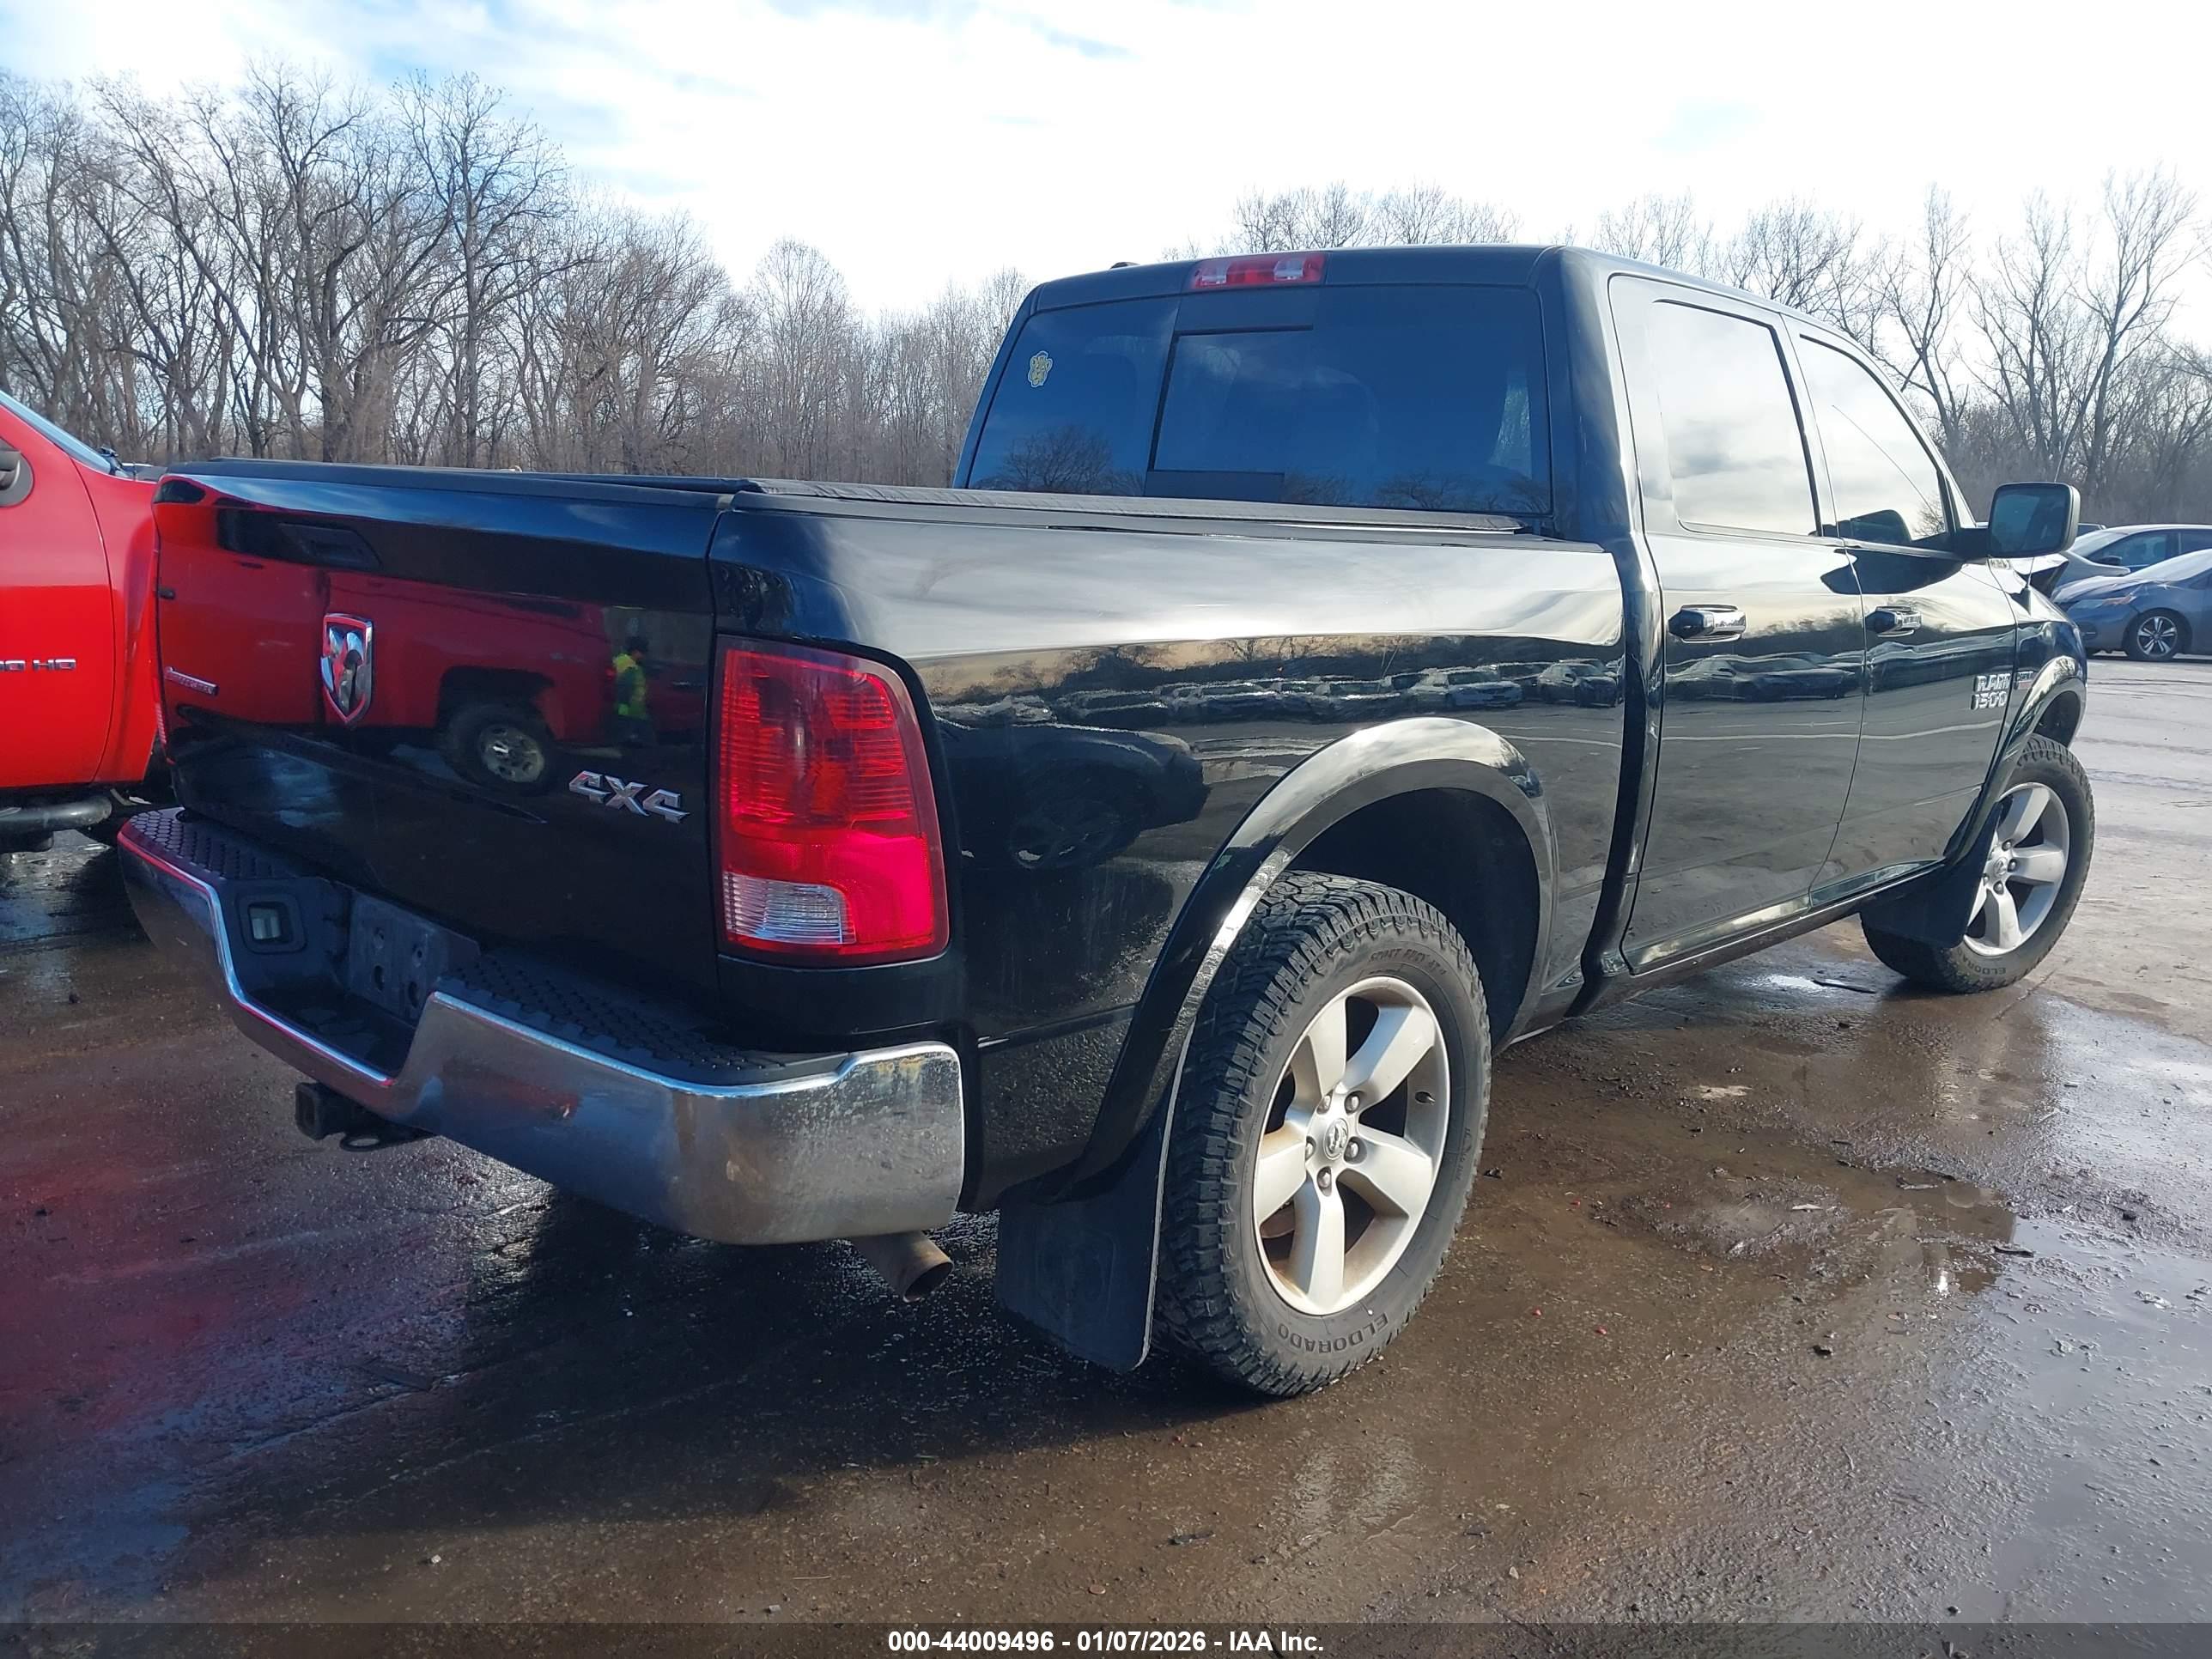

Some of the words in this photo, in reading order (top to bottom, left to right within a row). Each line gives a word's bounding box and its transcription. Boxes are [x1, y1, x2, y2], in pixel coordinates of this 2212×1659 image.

[33, 659, 76, 671] HD
[1974, 673, 2010, 691] RAM
[1972, 691, 2008, 710] 1500
[1277, 1312, 1389, 1354] ELDORADO
